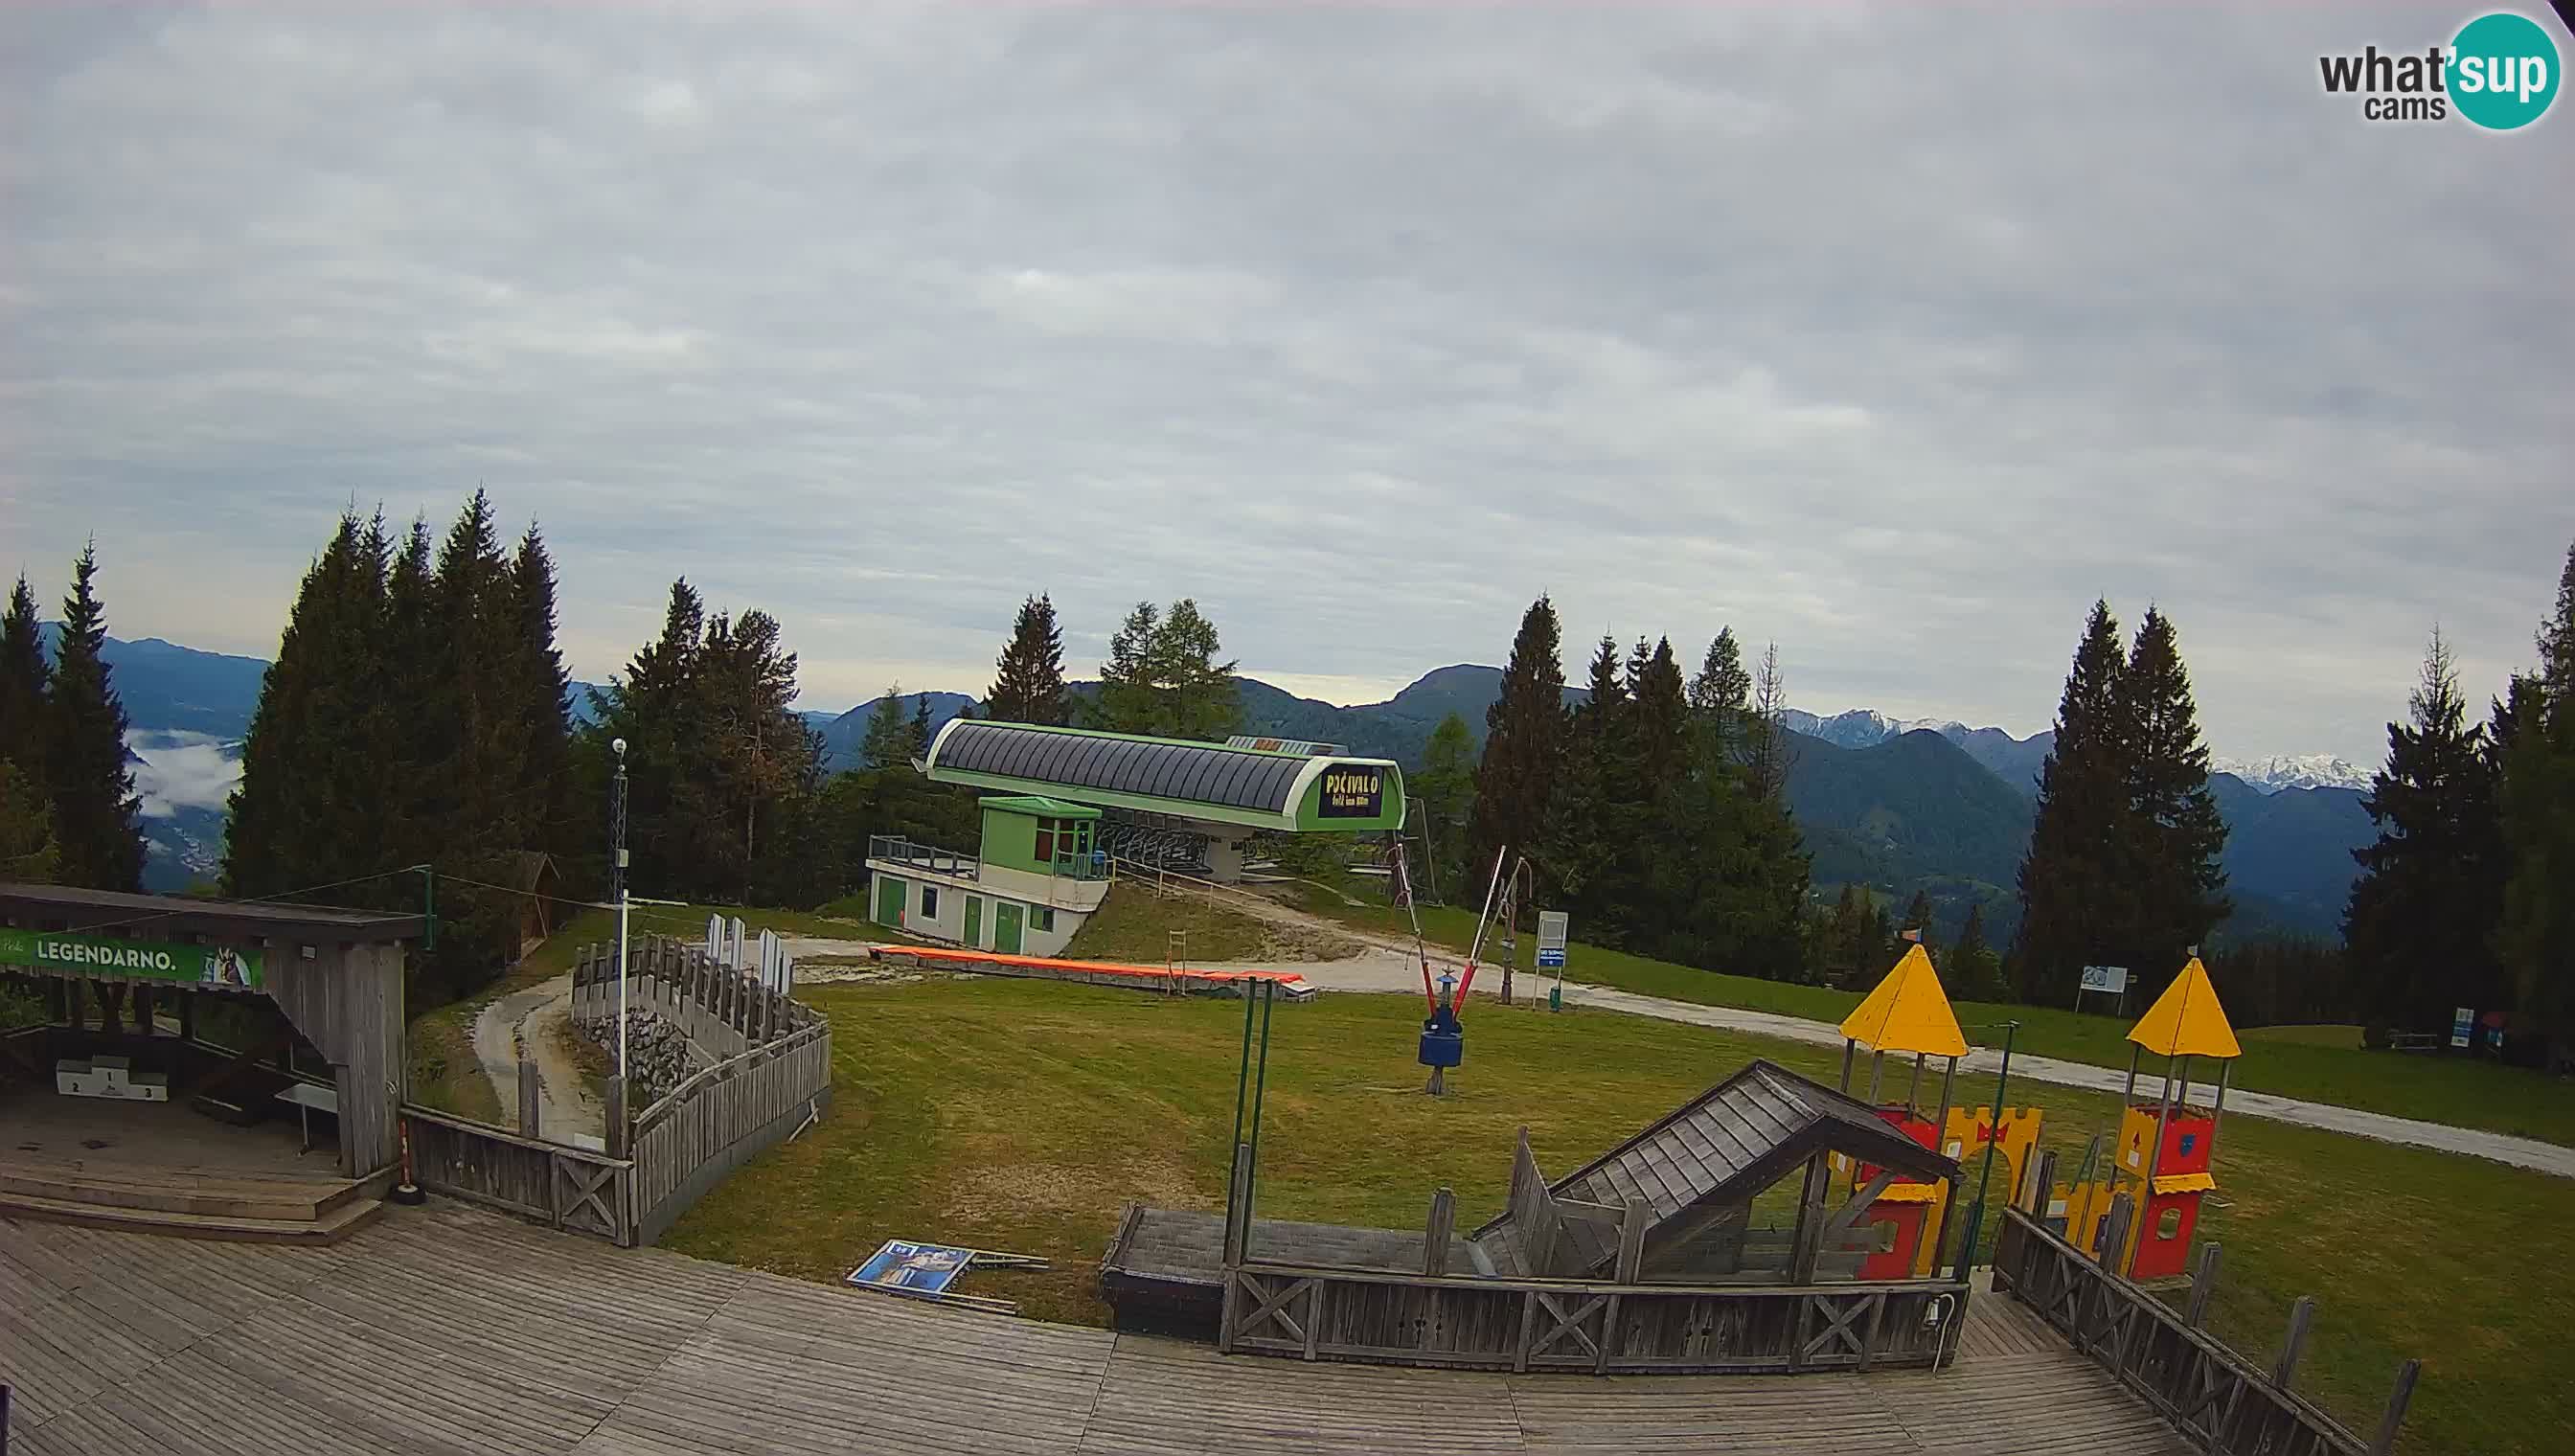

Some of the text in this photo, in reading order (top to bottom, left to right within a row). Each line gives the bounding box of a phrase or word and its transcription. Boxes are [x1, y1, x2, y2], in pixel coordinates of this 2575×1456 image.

[37, 940, 176, 971] LEGENDARNO.
[107, 1071, 112, 1081] 1
[72, 1082, 80, 1093] 2
[145, 1087, 152, 1098] 3
